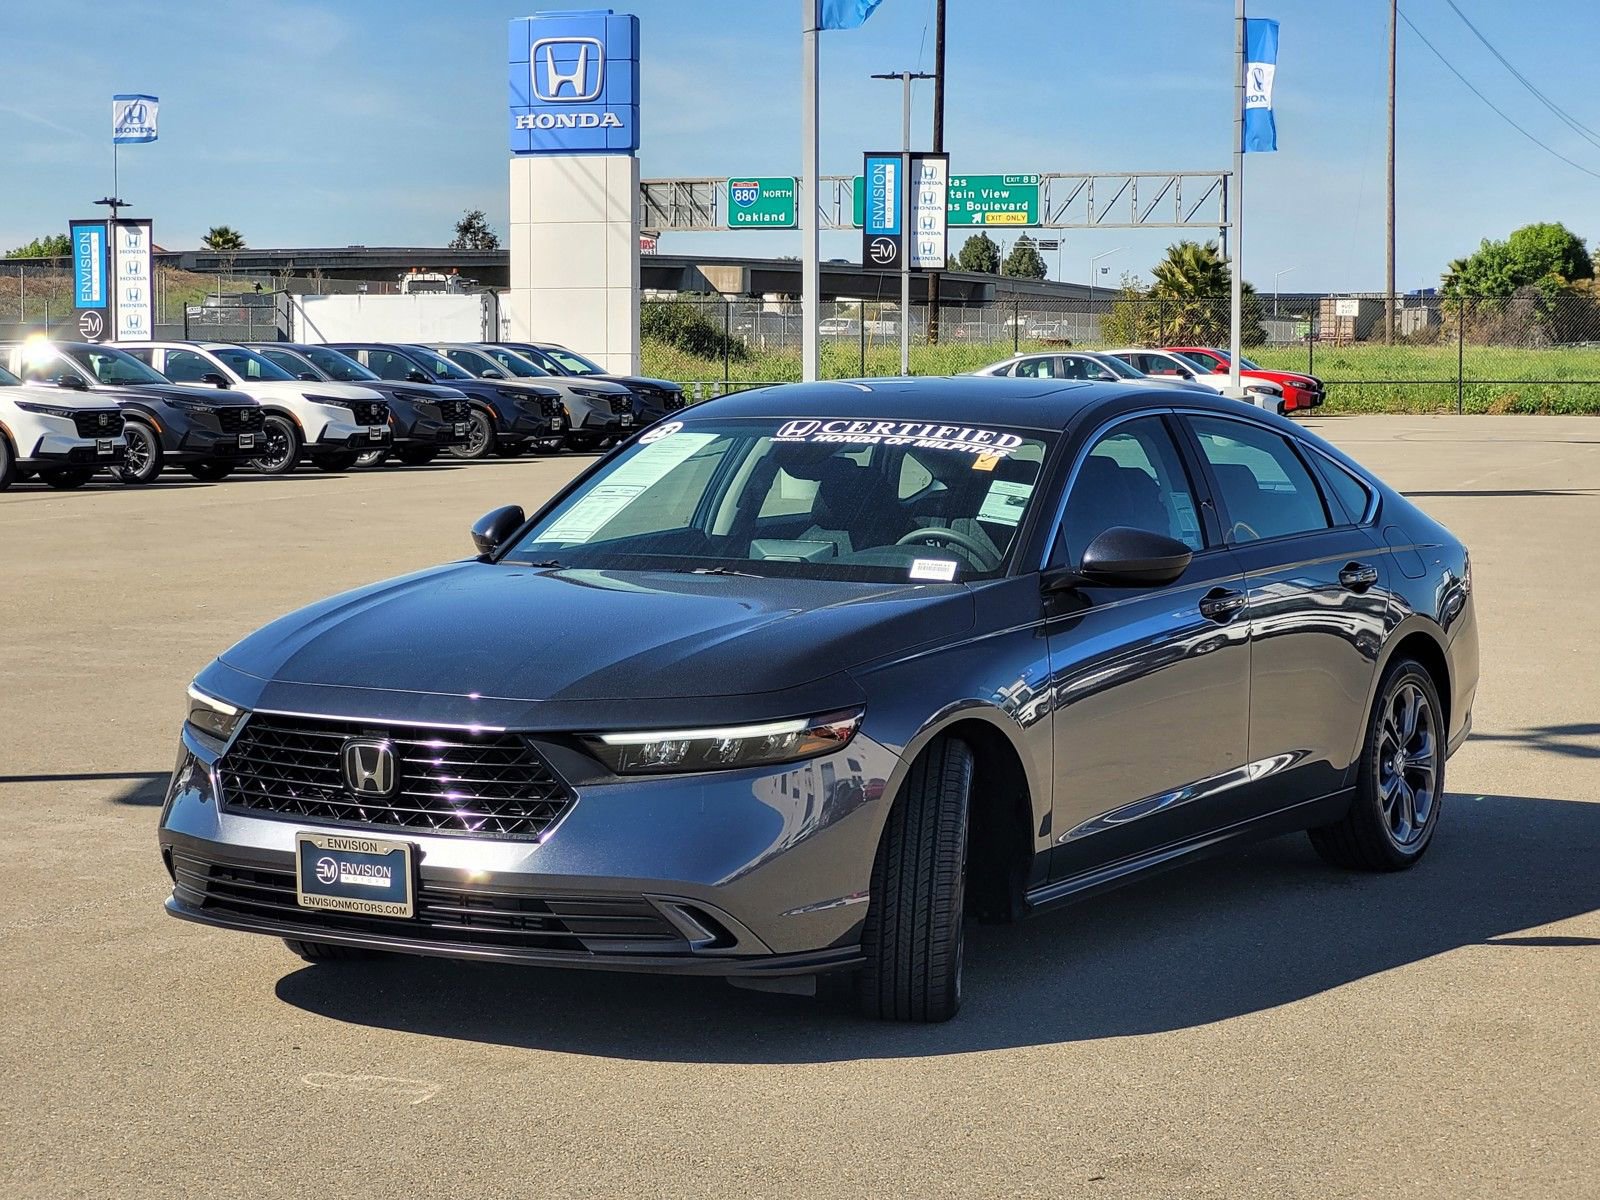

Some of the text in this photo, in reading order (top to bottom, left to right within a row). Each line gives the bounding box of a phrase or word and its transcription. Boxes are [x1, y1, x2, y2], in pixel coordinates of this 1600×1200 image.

[515, 112, 624, 129] HONDA
[735, 189, 792, 201] 880 NORTH
[872, 163, 885, 229] ENVISION
[950, 189, 1010, 198] tain View
[966, 201, 1029, 211] Boulevard
[737, 212, 785, 222] Oakland
[80, 232, 92, 302] ENVISION
[821, 420, 1023, 448] CERTIFIED
[811, 434, 1011, 458] HONDA OF MILPITAS
[327, 838, 377, 852] ENVISION
[340, 861, 392, 878] ENVISION
[303, 896, 408, 915] ENVISIONMOTORS.COM
